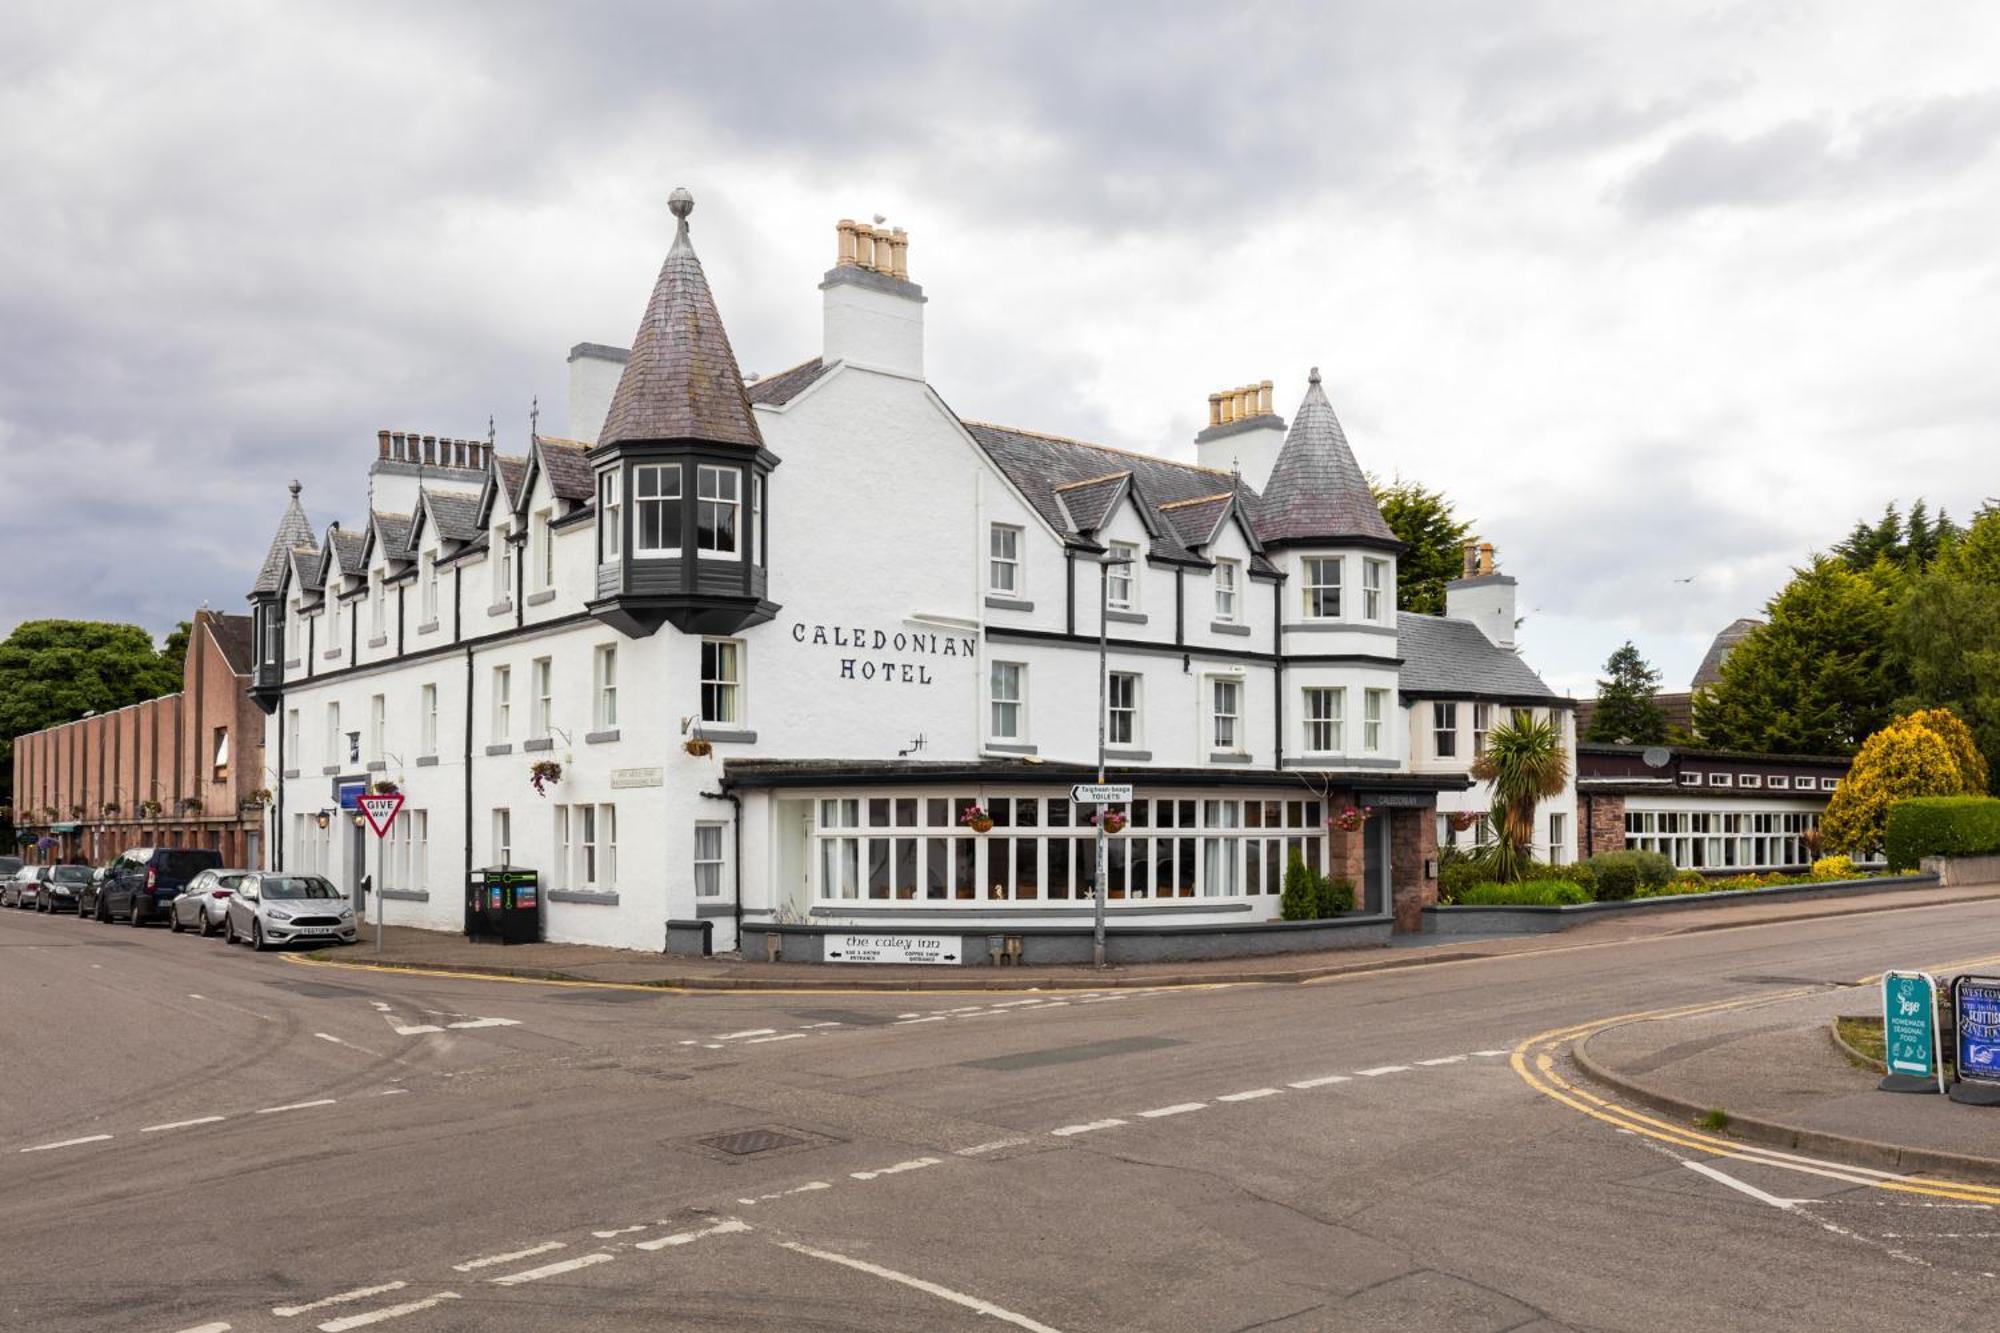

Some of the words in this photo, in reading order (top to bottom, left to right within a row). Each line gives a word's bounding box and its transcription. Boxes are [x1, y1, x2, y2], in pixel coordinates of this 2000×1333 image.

[792, 623, 975, 657] CALEDONIAN
[840, 658, 932, 684] HOTEL
[367, 800, 394, 809] GIVE
[846, 936, 869, 947] the
[875, 937, 912, 950] caley
[1962, 987, 1983, 997] WEST
[1969, 1010, 2000, 1024] SCOTTIS
[1900, 1034, 1918, 1043] FOOD
